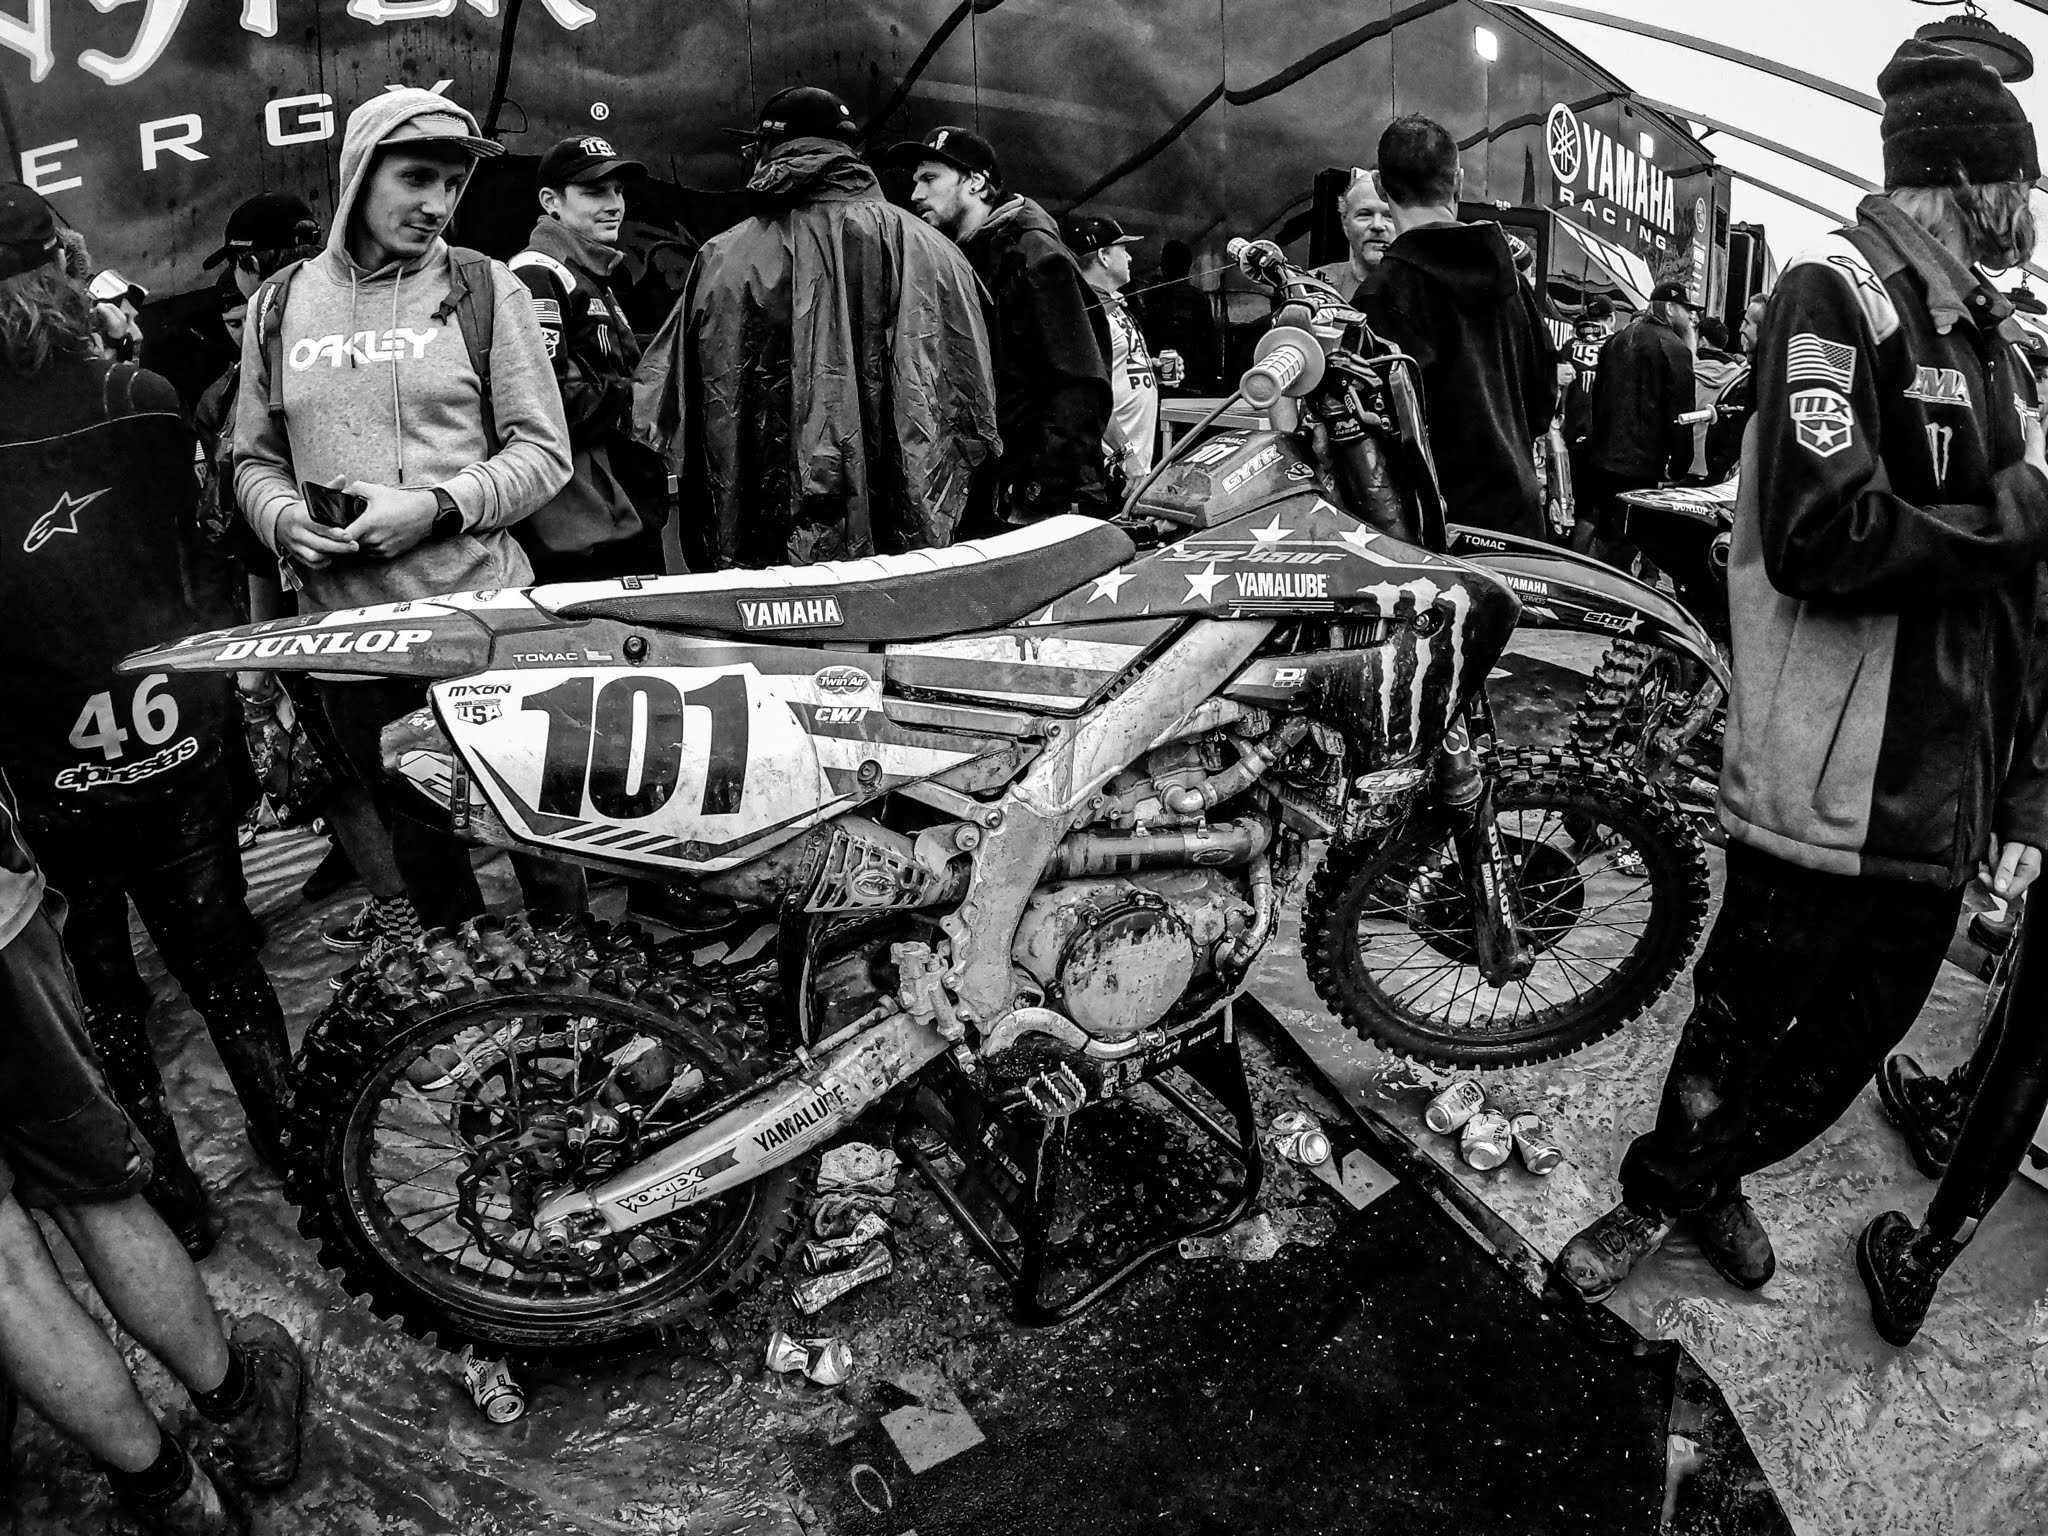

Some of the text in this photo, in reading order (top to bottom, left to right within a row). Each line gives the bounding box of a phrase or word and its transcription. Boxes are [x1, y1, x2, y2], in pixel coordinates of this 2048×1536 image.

[20, 79, 455, 197] ERG
[1583, 121, 1676, 236] YAMAHA
[1559, 186, 1667, 250] RACING
[289, 327, 439, 372] OAKLEY
[1221, 443, 1282, 493] GYTR
[1464, 534, 1507, 551] TOMAC
[1234, 571, 1330, 598] YAMALUBE
[1506, 576, 1548, 595] YAMAHA
[741, 599, 840, 626] YAMAHA
[214, 629, 433, 662] DUNLOP
[512, 652, 579, 662] TOMAC
[819, 675, 867, 686] Twin Air
[68, 673, 179, 761] 46
[54, 736, 199, 792] alpinestars
[520, 674, 749, 820] 101
[1487, 821, 1513, 929] DUNLOP
[616, 1166, 704, 1213] VORTEX
